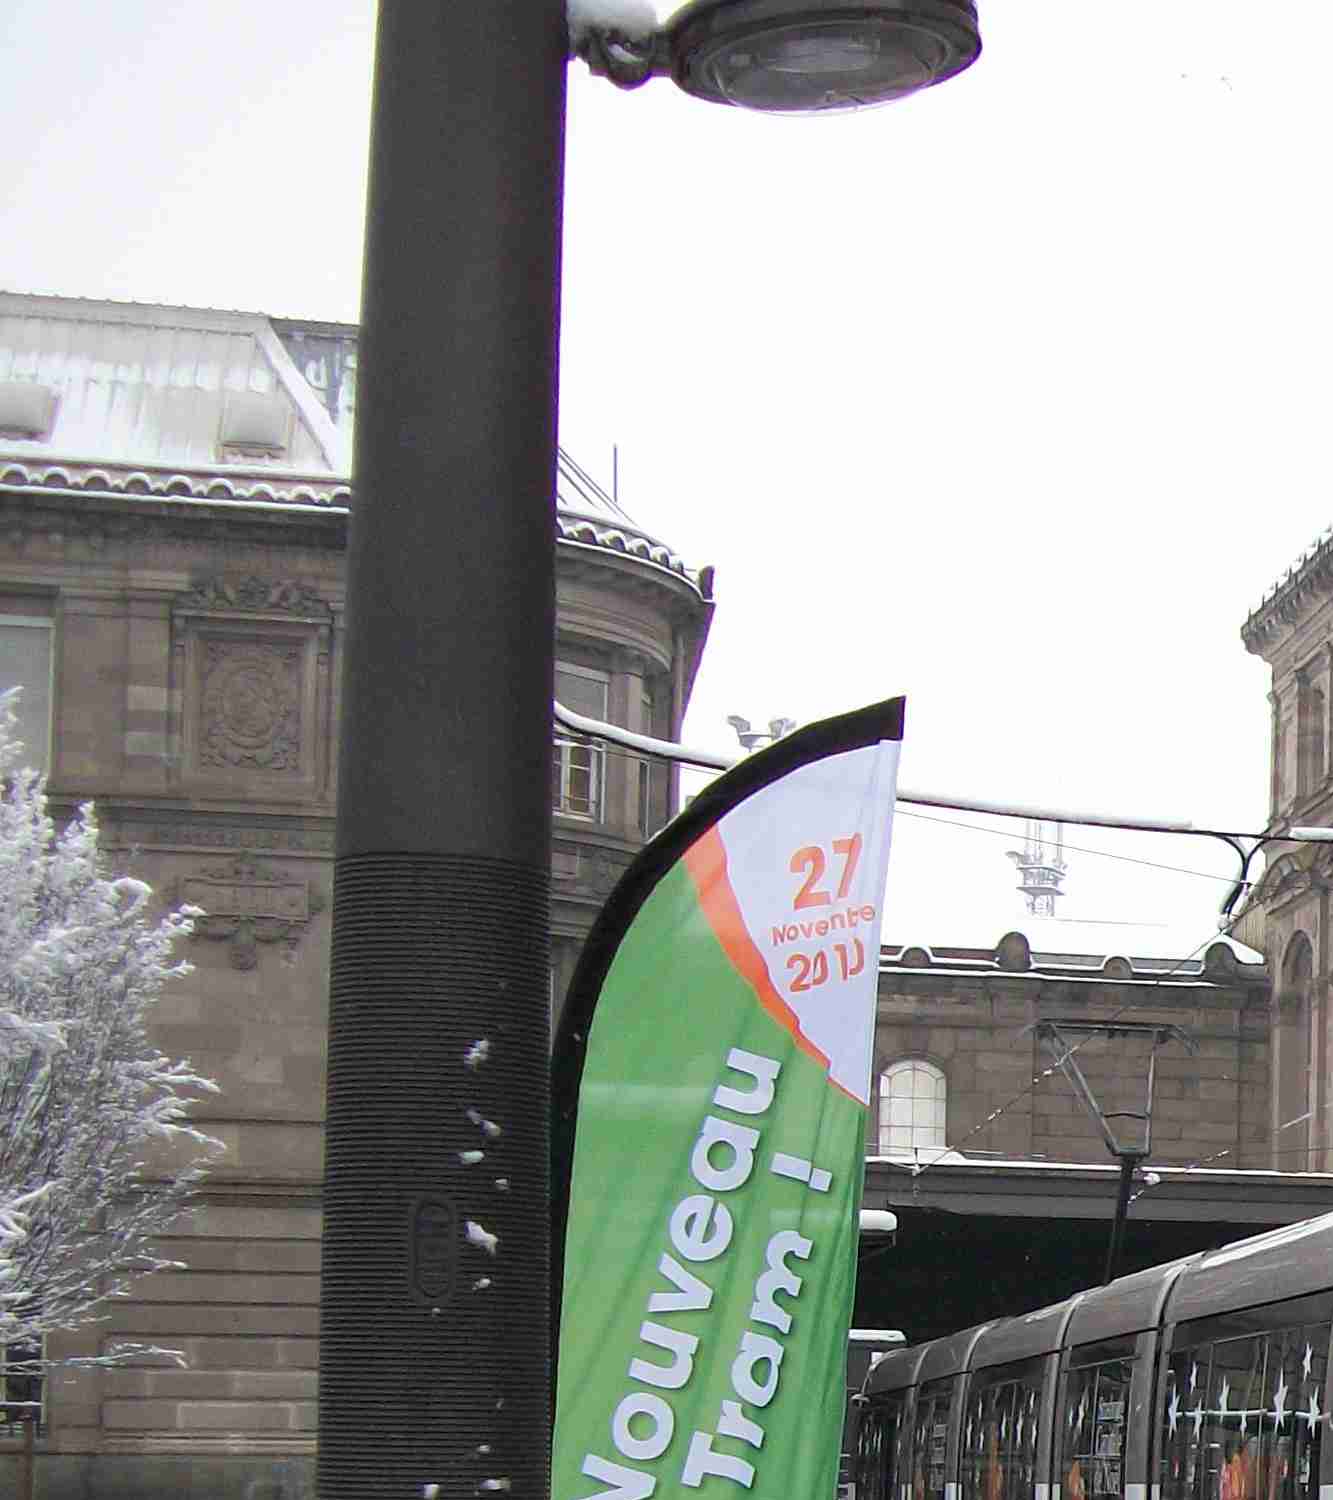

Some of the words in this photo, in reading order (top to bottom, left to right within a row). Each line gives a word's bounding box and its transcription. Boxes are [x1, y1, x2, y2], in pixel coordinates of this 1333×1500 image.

[790, 832, 863, 910] 27
[681, 1229, 814, 1489] Tram
[770, 1151, 833, 1193] !
